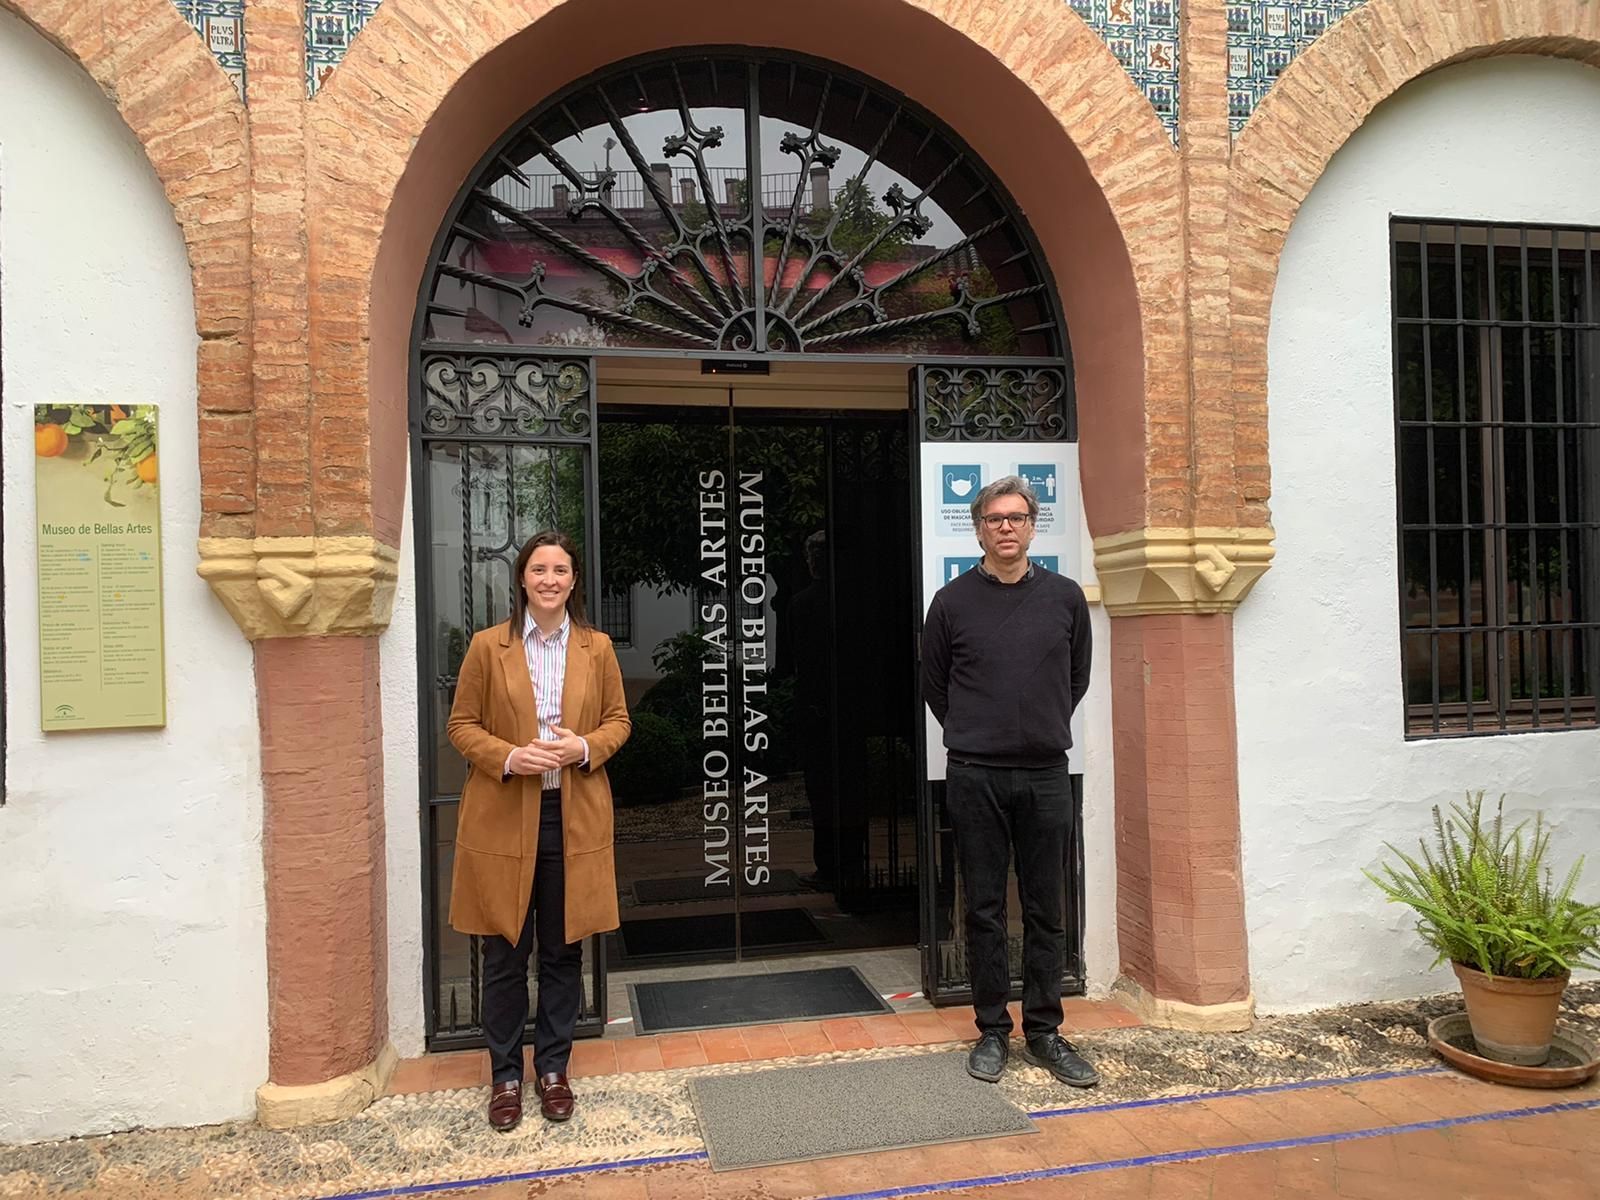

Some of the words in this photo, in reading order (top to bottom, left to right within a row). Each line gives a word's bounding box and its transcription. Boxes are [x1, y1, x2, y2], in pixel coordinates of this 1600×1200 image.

[211, 25, 234, 35] PLVS
[211, 35, 234, 46] VLTRA
[42, 524, 75, 535] Museo
[78, 524, 91, 535] de
[94, 523, 124, 535] Bellas
[126, 523, 153, 534] Artes
[699, 469, 727, 588] ARTES
[739, 470, 766, 605] MUSEO
[701, 603, 729, 740] BELLAS
[742, 616, 769, 752] BELLAS
[703, 750, 730, 887] MUSEO
[743, 766, 770, 886] ARTES
